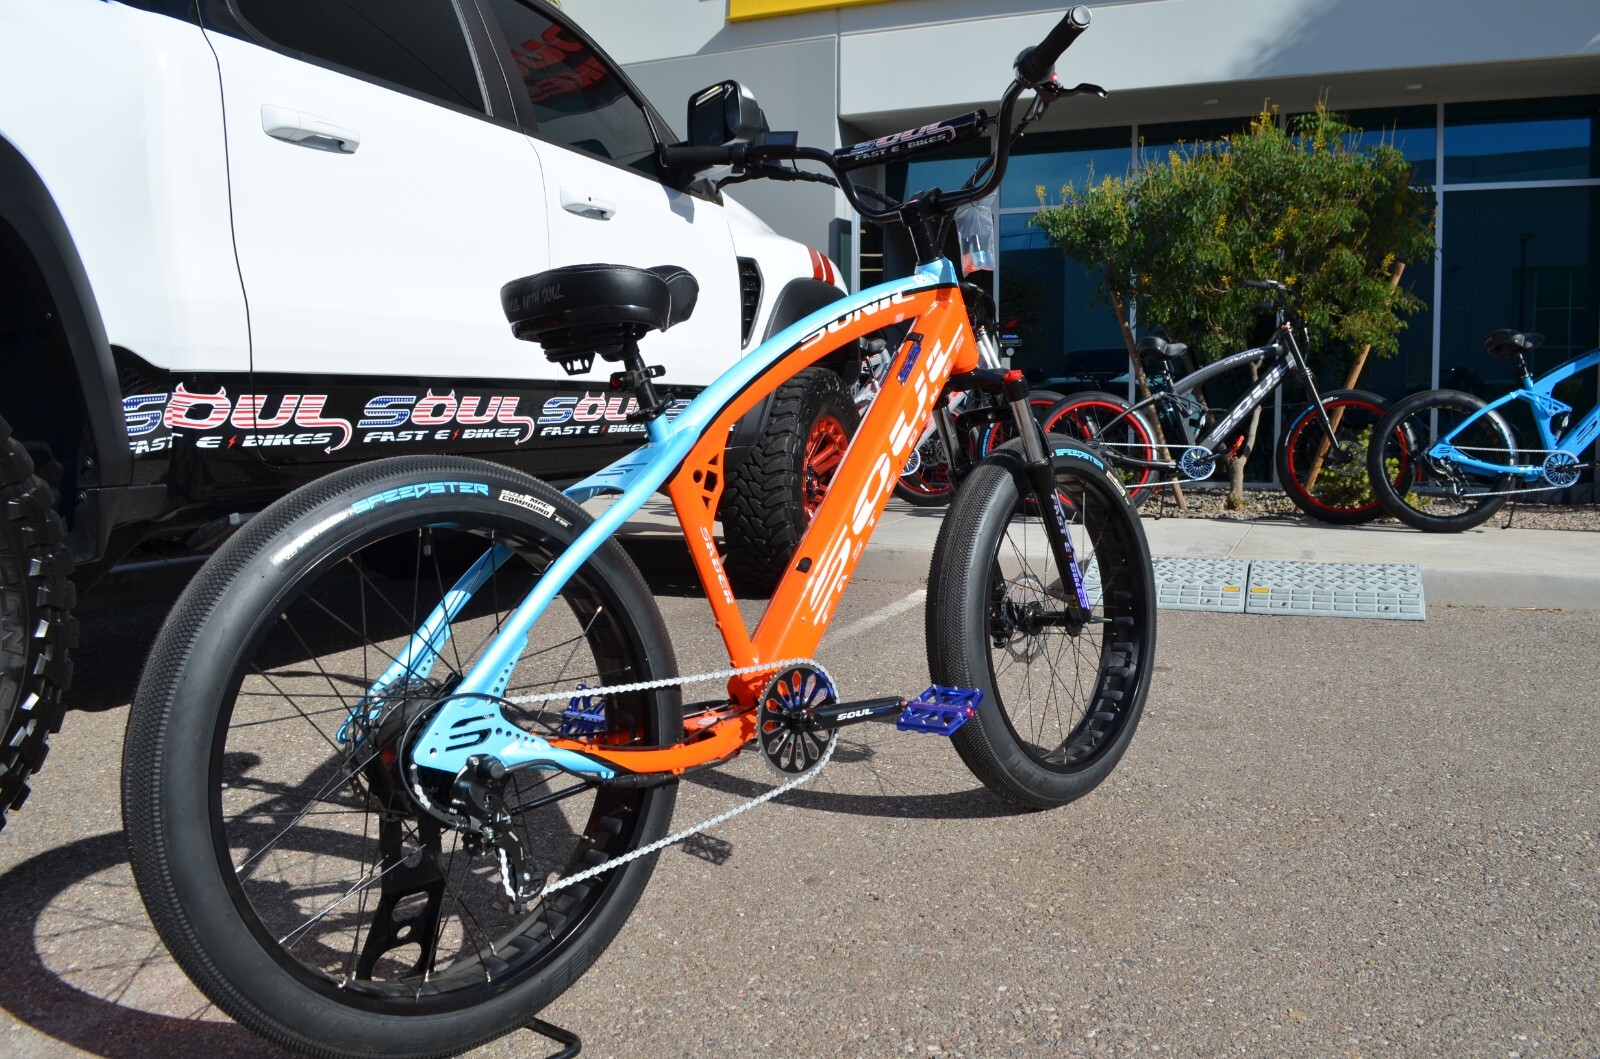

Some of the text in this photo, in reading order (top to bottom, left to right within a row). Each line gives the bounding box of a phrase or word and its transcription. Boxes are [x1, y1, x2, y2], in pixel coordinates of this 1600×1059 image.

[851, 121, 956, 154] SOUL
[855, 148, 888, 161] FAST
[907, 133, 946, 149] BIKES
[541, 284, 566, 305] SOUL
[800, 283, 915, 352] SONIC
[123, 382, 353, 453] SOUL
[357, 388, 534, 445] SOUL
[537, 391, 641, 424] SOU
[196, 436, 223, 448] E
[242, 432, 333, 447] BIKES
[363, 427, 520, 443] FAST E BIKES
[540, 425, 585, 437] FAST
[588, 424, 600, 434] E
[809, 322, 964, 627] SOUL
[351, 481, 489, 515] SPEEDSTER
[502, 495, 550, 516] COMPOUND
[529, 498, 550, 509] MPC
[700, 526, 733, 605] SABER
[836, 708, 874, 722] SOUL
